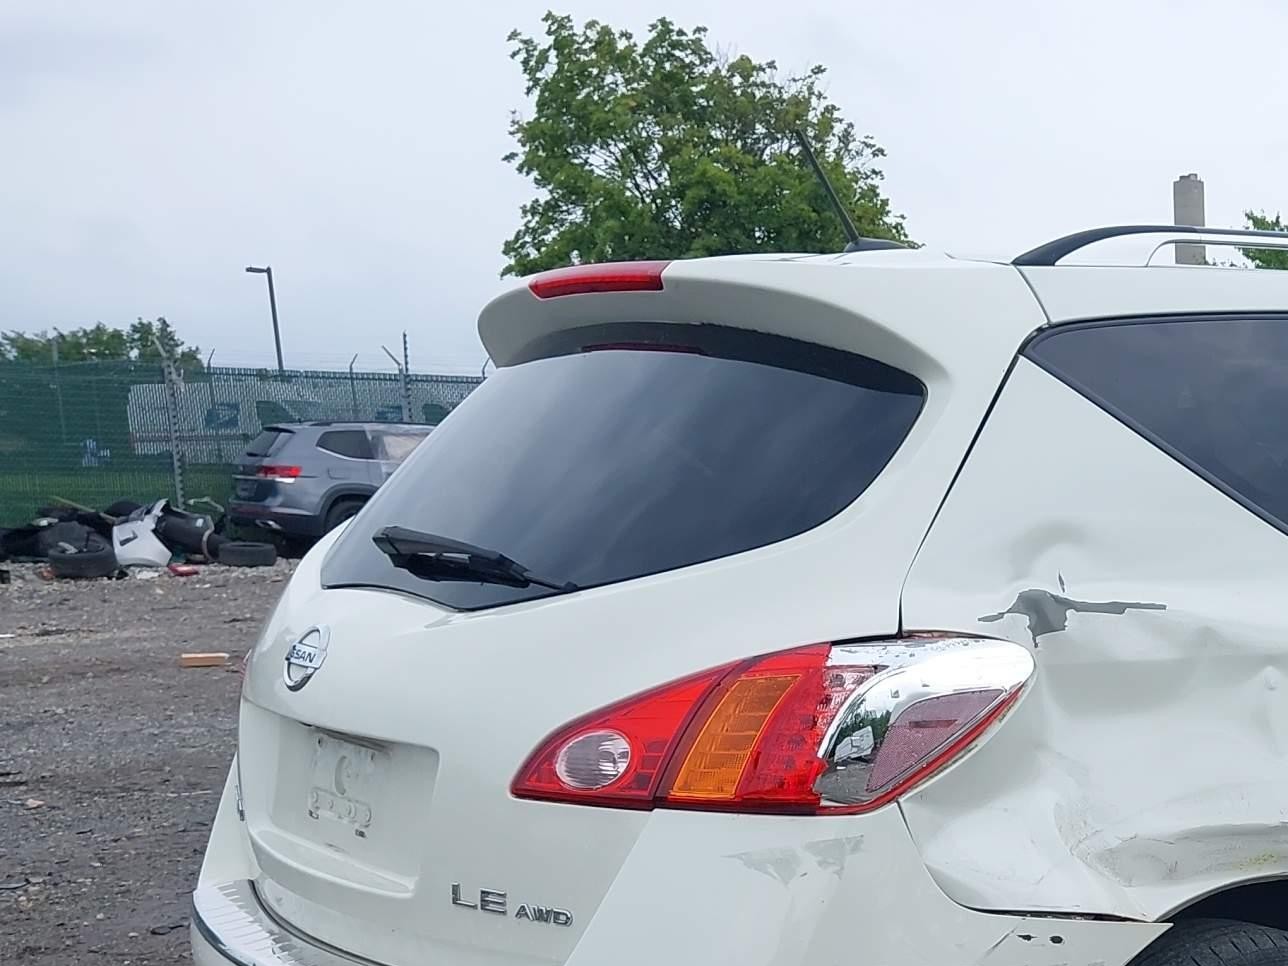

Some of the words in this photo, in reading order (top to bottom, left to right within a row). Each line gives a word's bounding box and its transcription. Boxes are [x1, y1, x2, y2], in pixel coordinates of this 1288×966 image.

[287, 643, 317, 664] SSAN
[451, 882, 507, 916] LE
[514, 903, 573, 927] AWD
